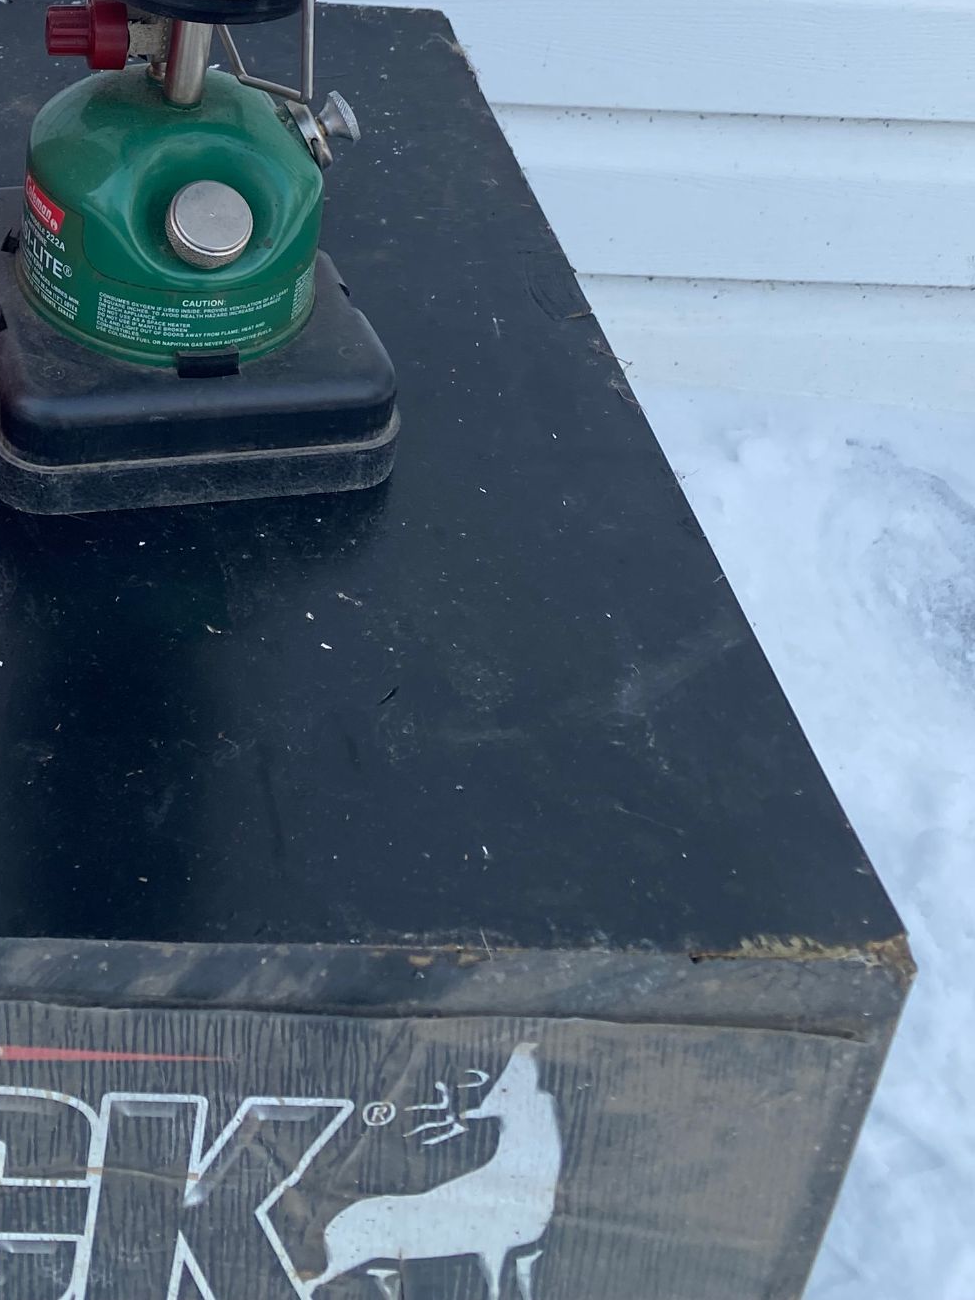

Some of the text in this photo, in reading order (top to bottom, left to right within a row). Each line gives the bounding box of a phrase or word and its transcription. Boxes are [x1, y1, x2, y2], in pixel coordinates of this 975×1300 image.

[46, 230, 66, 252] 222A
[107, 304, 123, 312] EACH
[131, 301, 155, 311] OXYGEN
[122, 323, 138, 332] LIGHT
[138, 322, 162, 331] MANTLE
[107, 329, 136, 340] COLEMAN
